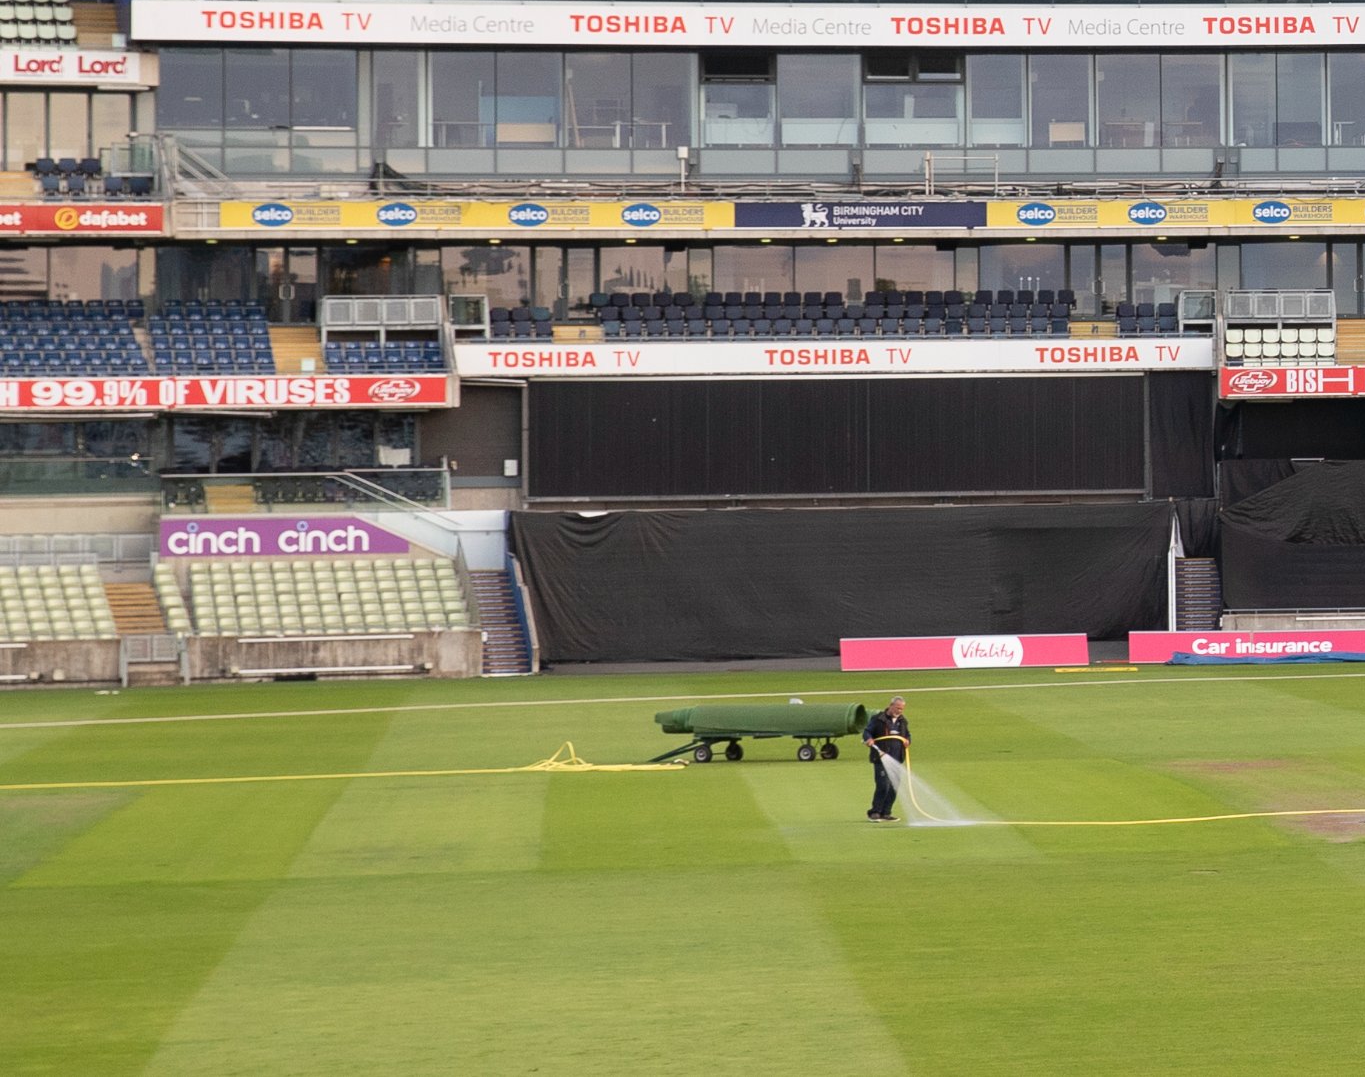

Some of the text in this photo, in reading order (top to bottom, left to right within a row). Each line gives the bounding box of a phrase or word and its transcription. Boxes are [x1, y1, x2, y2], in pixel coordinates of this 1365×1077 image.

[202, 11, 323, 29] TOSHIBA
[342, 13, 371, 30] TV
[411, 16, 467, 32] Media
[473, 16, 534, 33] Centre
[570, 15, 686, 33] TOSHIBA
[705, 17, 734, 34] TV
[753, 18, 807, 35] Media
[812, 18, 871, 35] Centre
[891, 18, 1005, 34] TOSHIBA
[1023, 18, 1051, 35] TV
[1069, 19, 1121, 35] Media
[1127, 19, 1184, 35] Centre
[1203, 17, 1315, 34] TOSHIBA
[1333, 17, 1359, 33] TV
[254, 210, 292, 221] selco
[378, 210, 416, 221] selco
[509, 210, 547, 221] selco
[622, 210, 661, 221] selco
[833, 206, 924, 215] BIRMINGHAM CITY
[1019, 208, 1054, 220] selco
[1129, 207, 1165, 219] selco
[1254, 207, 1289, 218] selco
[79, 210, 147, 228] dafabet
[833, 217, 876, 226] University
[488, 346, 1180, 367] TOSHIBA TV TOSHIBA TV TOSHIBA TV
[1286, 369, 1353, 393] BISH
[32, 380, 147, 406] 99.9%
[159, 379, 190, 405] OF
[200, 379, 351, 404] VIRUSES
[168, 520, 369, 555] cinch cinch
[960, 641, 1014, 662] Vitality
[1192, 638, 1230, 655] Car
[1235, 636, 1332, 654] insurance
